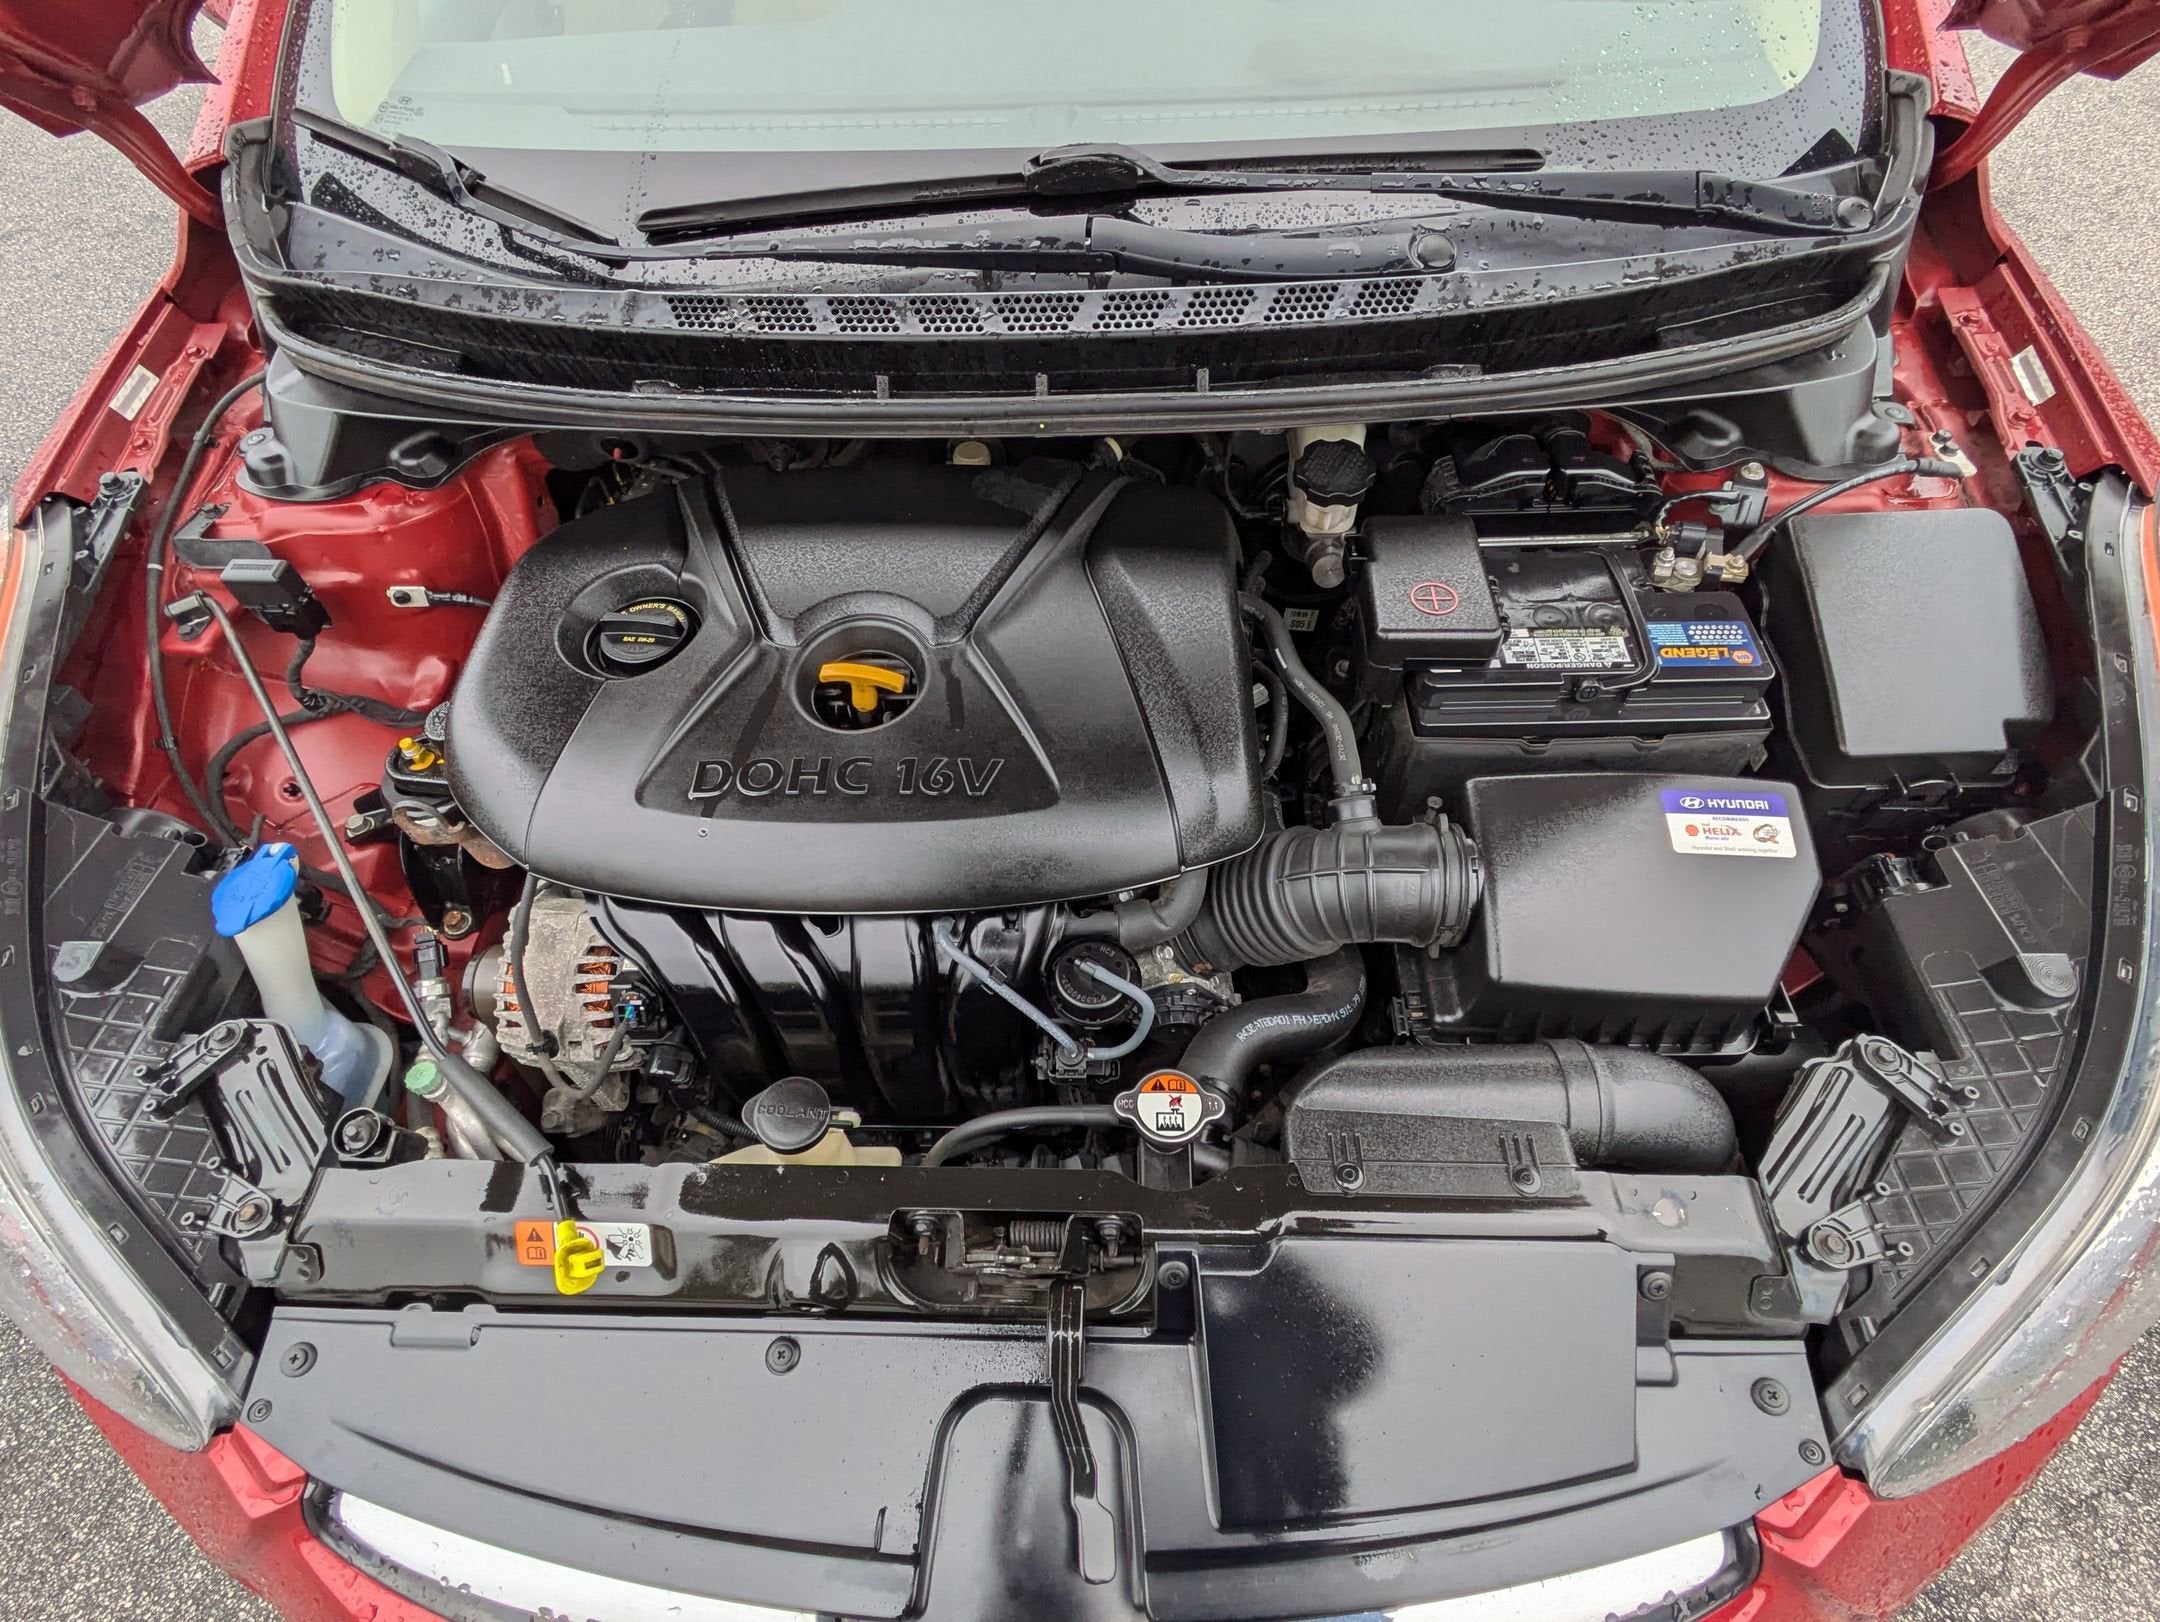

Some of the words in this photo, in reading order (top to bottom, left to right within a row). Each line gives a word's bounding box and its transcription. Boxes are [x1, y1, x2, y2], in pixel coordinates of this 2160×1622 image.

[1660, 646, 1730, 658] LEGEND
[688, 756, 873, 800] DOHC
[896, 756, 1005, 797] 16V
[1707, 798, 1769, 810] HYUNDAI
[1703, 826, 1743, 836] HELIX
[757, 1103, 829, 1120] COOLANT
